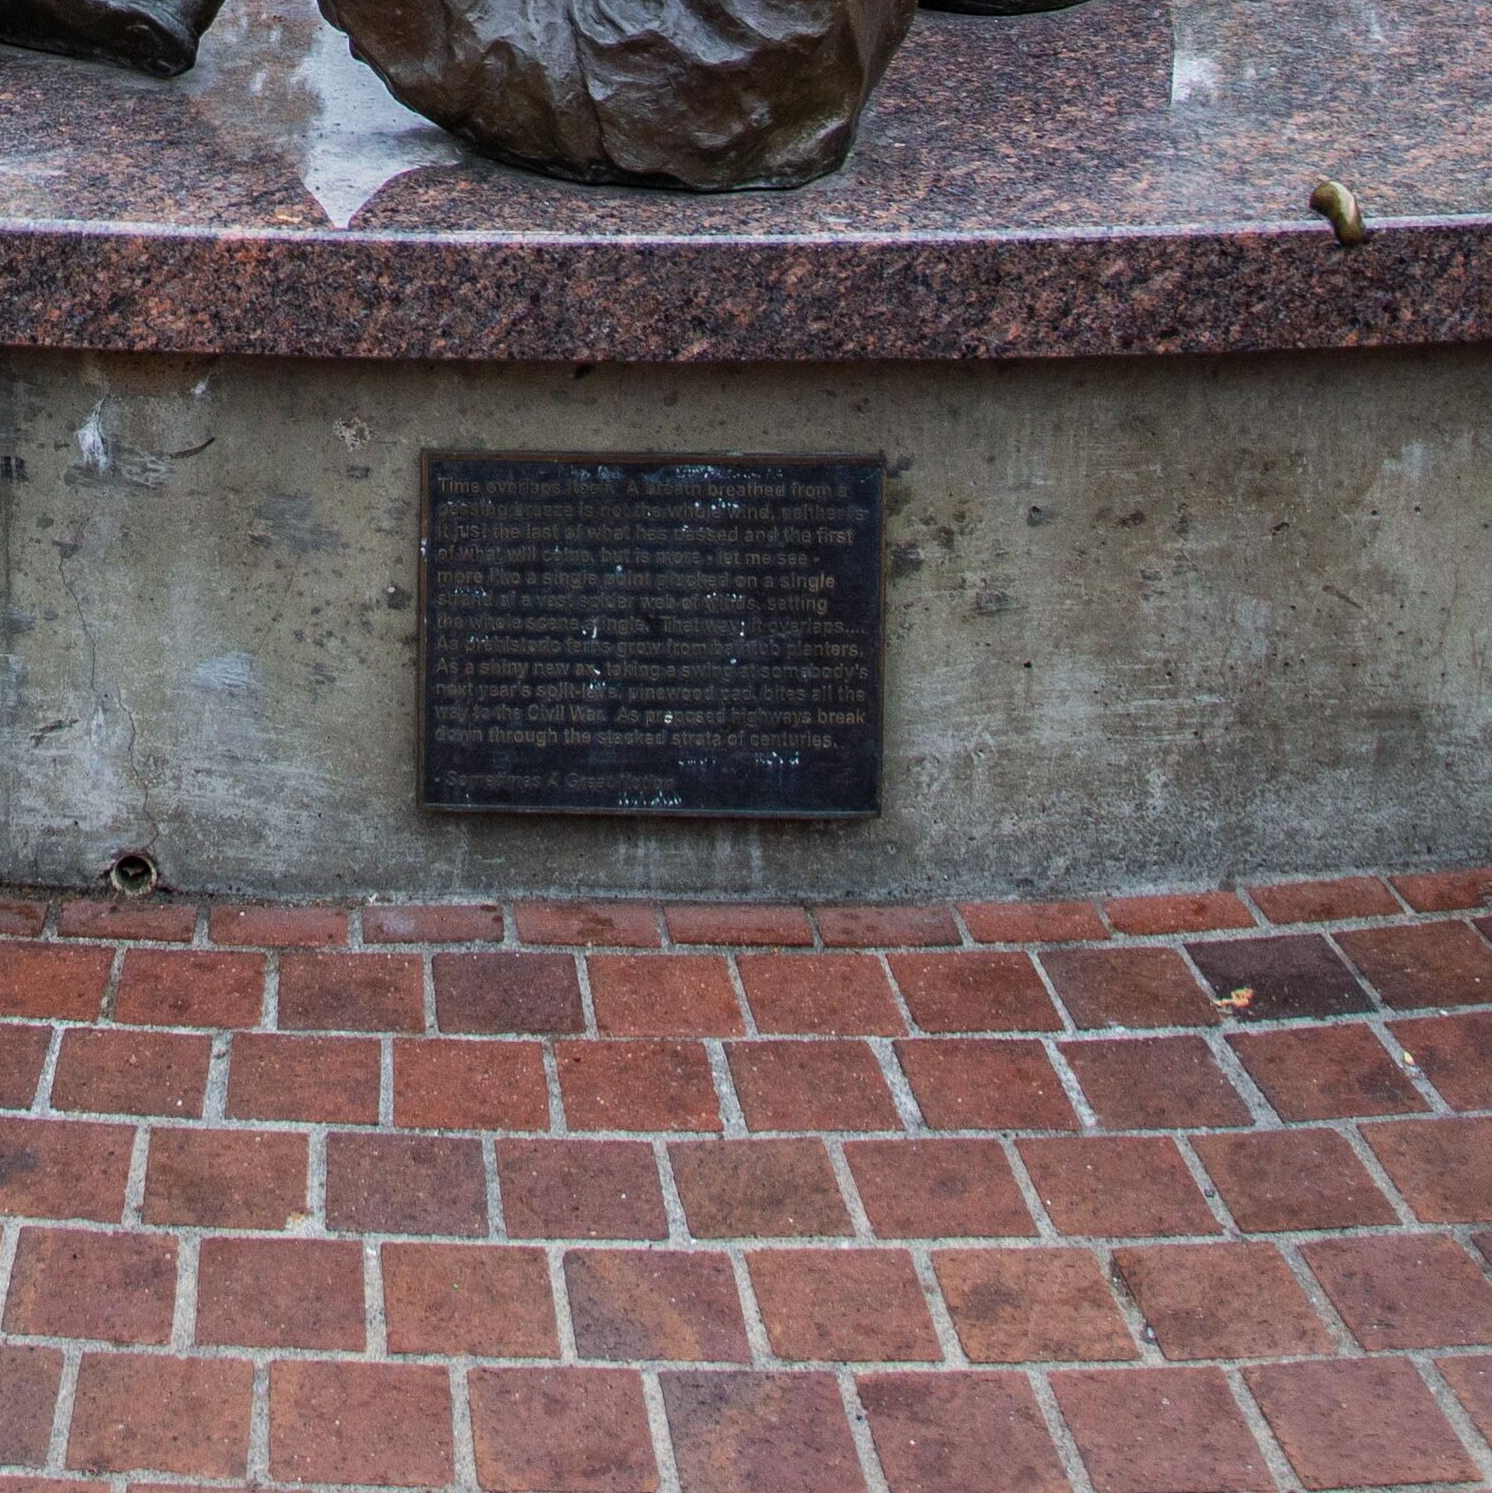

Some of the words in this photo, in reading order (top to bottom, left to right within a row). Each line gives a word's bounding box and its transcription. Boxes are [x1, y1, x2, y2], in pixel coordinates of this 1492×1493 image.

[438, 478, 479, 493] Time
[707, 480, 785, 496] breathed
[791, 481, 831, 496] from
[837, 485, 848, 497] a
[579, 502, 593, 517] is
[451, 523, 486, 542] just
[492, 524, 520, 539] the
[527, 524, 558, 540] last
[565, 524, 584, 540] of
[588, 525, 629, 540] what
[744, 526, 777, 542] and
[783, 527, 812, 542] the
[816, 527, 854, 542] first
[438, 546, 455, 561] of
[507, 547, 536, 562] will
[601, 547, 631, 563] but
[635, 548, 650, 563] is
[717, 549, 740, 564] let
[745, 553, 771, 564] me
[777, 553, 807, 565] see
[437, 571, 483, 583] more
[526, 572, 536, 584] a
[542, 569, 597, 588] single
[734, 575, 757, 586] on
[763, 575, 774, 587] a
[780, 572, 835, 590] single
[520, 595, 531, 607] a
[767, 595, 828, 614] setting
[437, 612, 463, 628] the
[469, 613, 521, 628] whole
[526, 617, 578, 629] scene
[662, 615, 699, 631] That
[437, 634, 458, 649] As
[616, 641, 661, 656] grow
[667, 638, 706, 653] from
[436, 657, 458, 672] As
[464, 661, 474, 673] a
[479, 658, 528, 676] shiny
[533, 662, 569, 674] new
[606, 660, 660, 679] taking
[667, 664, 676, 676] a
[435, 681, 473, 696] next
[478, 681, 531, 700] year's
[628, 683, 713, 702] pinewood
[762, 685, 805, 700] bites
[811, 685, 831, 701] all
[837, 686, 865, 701] the
[435, 707, 468, 722] way
[494, 704, 521, 720] the
[527, 705, 564, 720] Civil
[616, 706, 638, 721] As
[817, 708, 865, 724] break
[488, 727, 557, 746] through
[563, 728, 591, 743] the
[672, 730, 721, 745] strata
[727, 731, 746, 746] of
